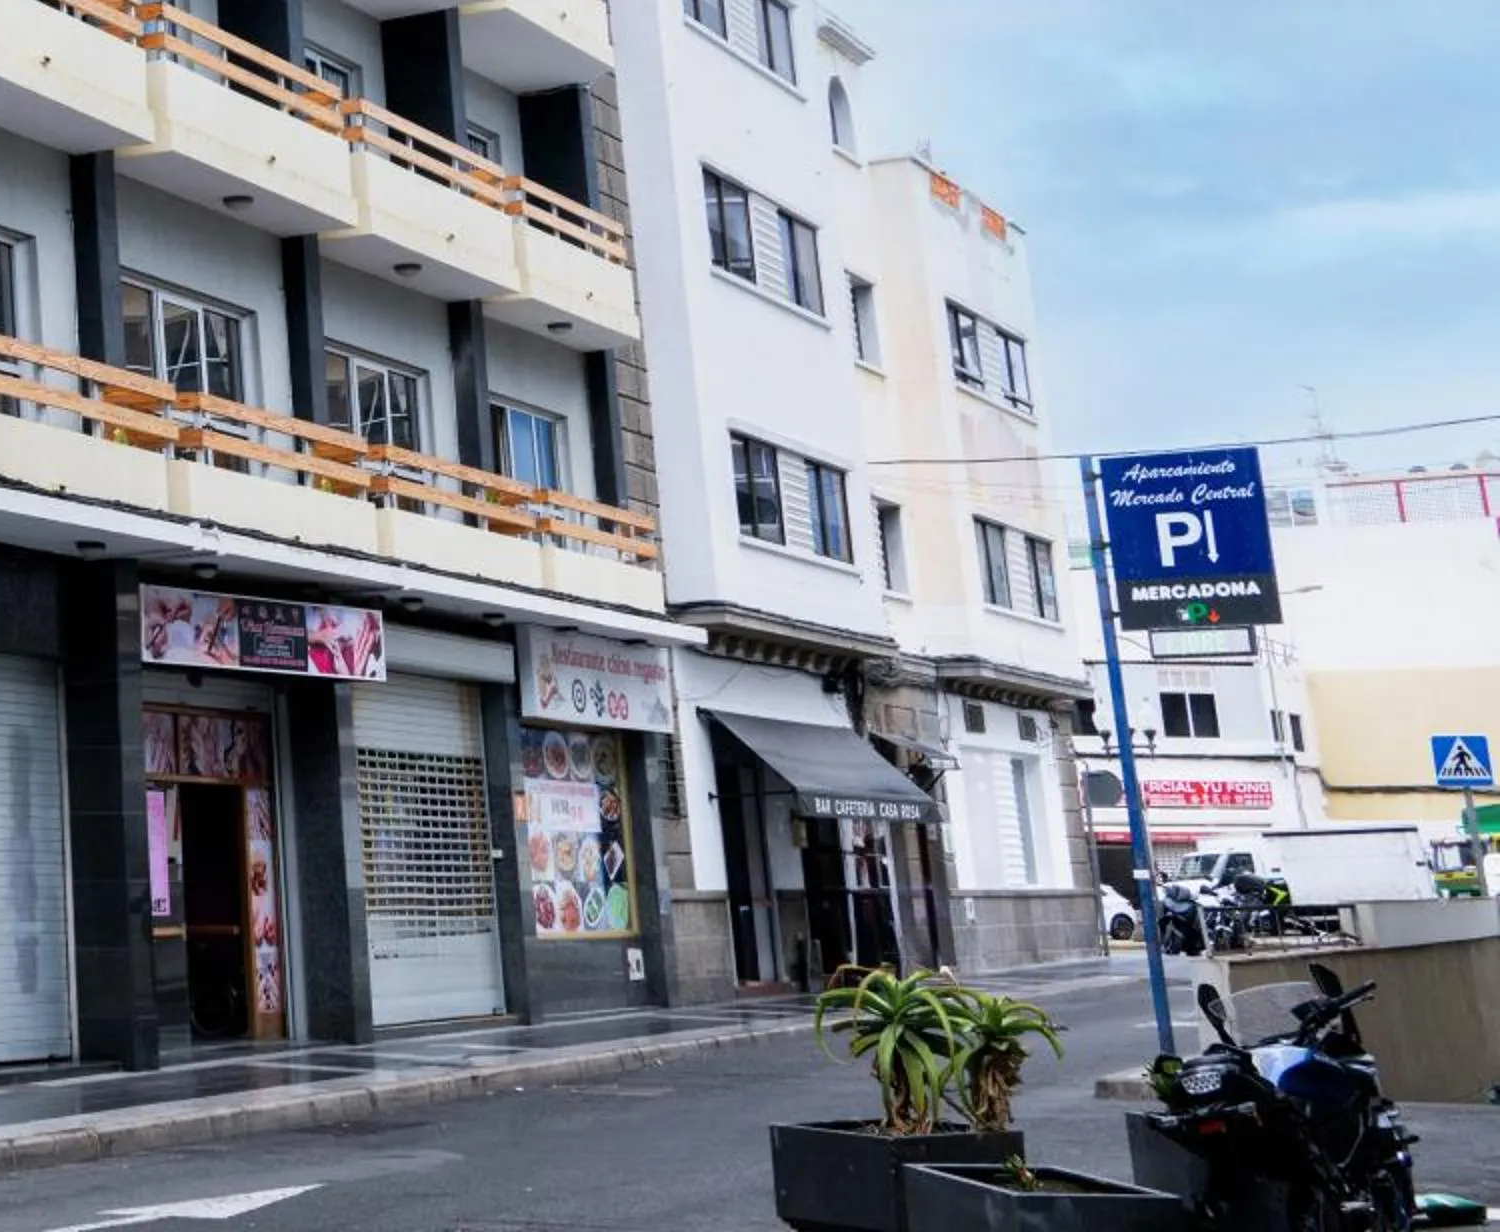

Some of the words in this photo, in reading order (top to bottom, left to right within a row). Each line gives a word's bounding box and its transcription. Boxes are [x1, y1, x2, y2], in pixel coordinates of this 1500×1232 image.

[1121, 460, 1237, 483] Aparcamiento
[1109, 488, 1185, 508] Mercado
[1190, 481, 1256, 506] Central
[1155, 511, 1203, 568] P
[1131, 581, 1262, 602] MERCADONA
[814, 797, 831, 814] BAR
[879, 802, 899, 817] CASA
